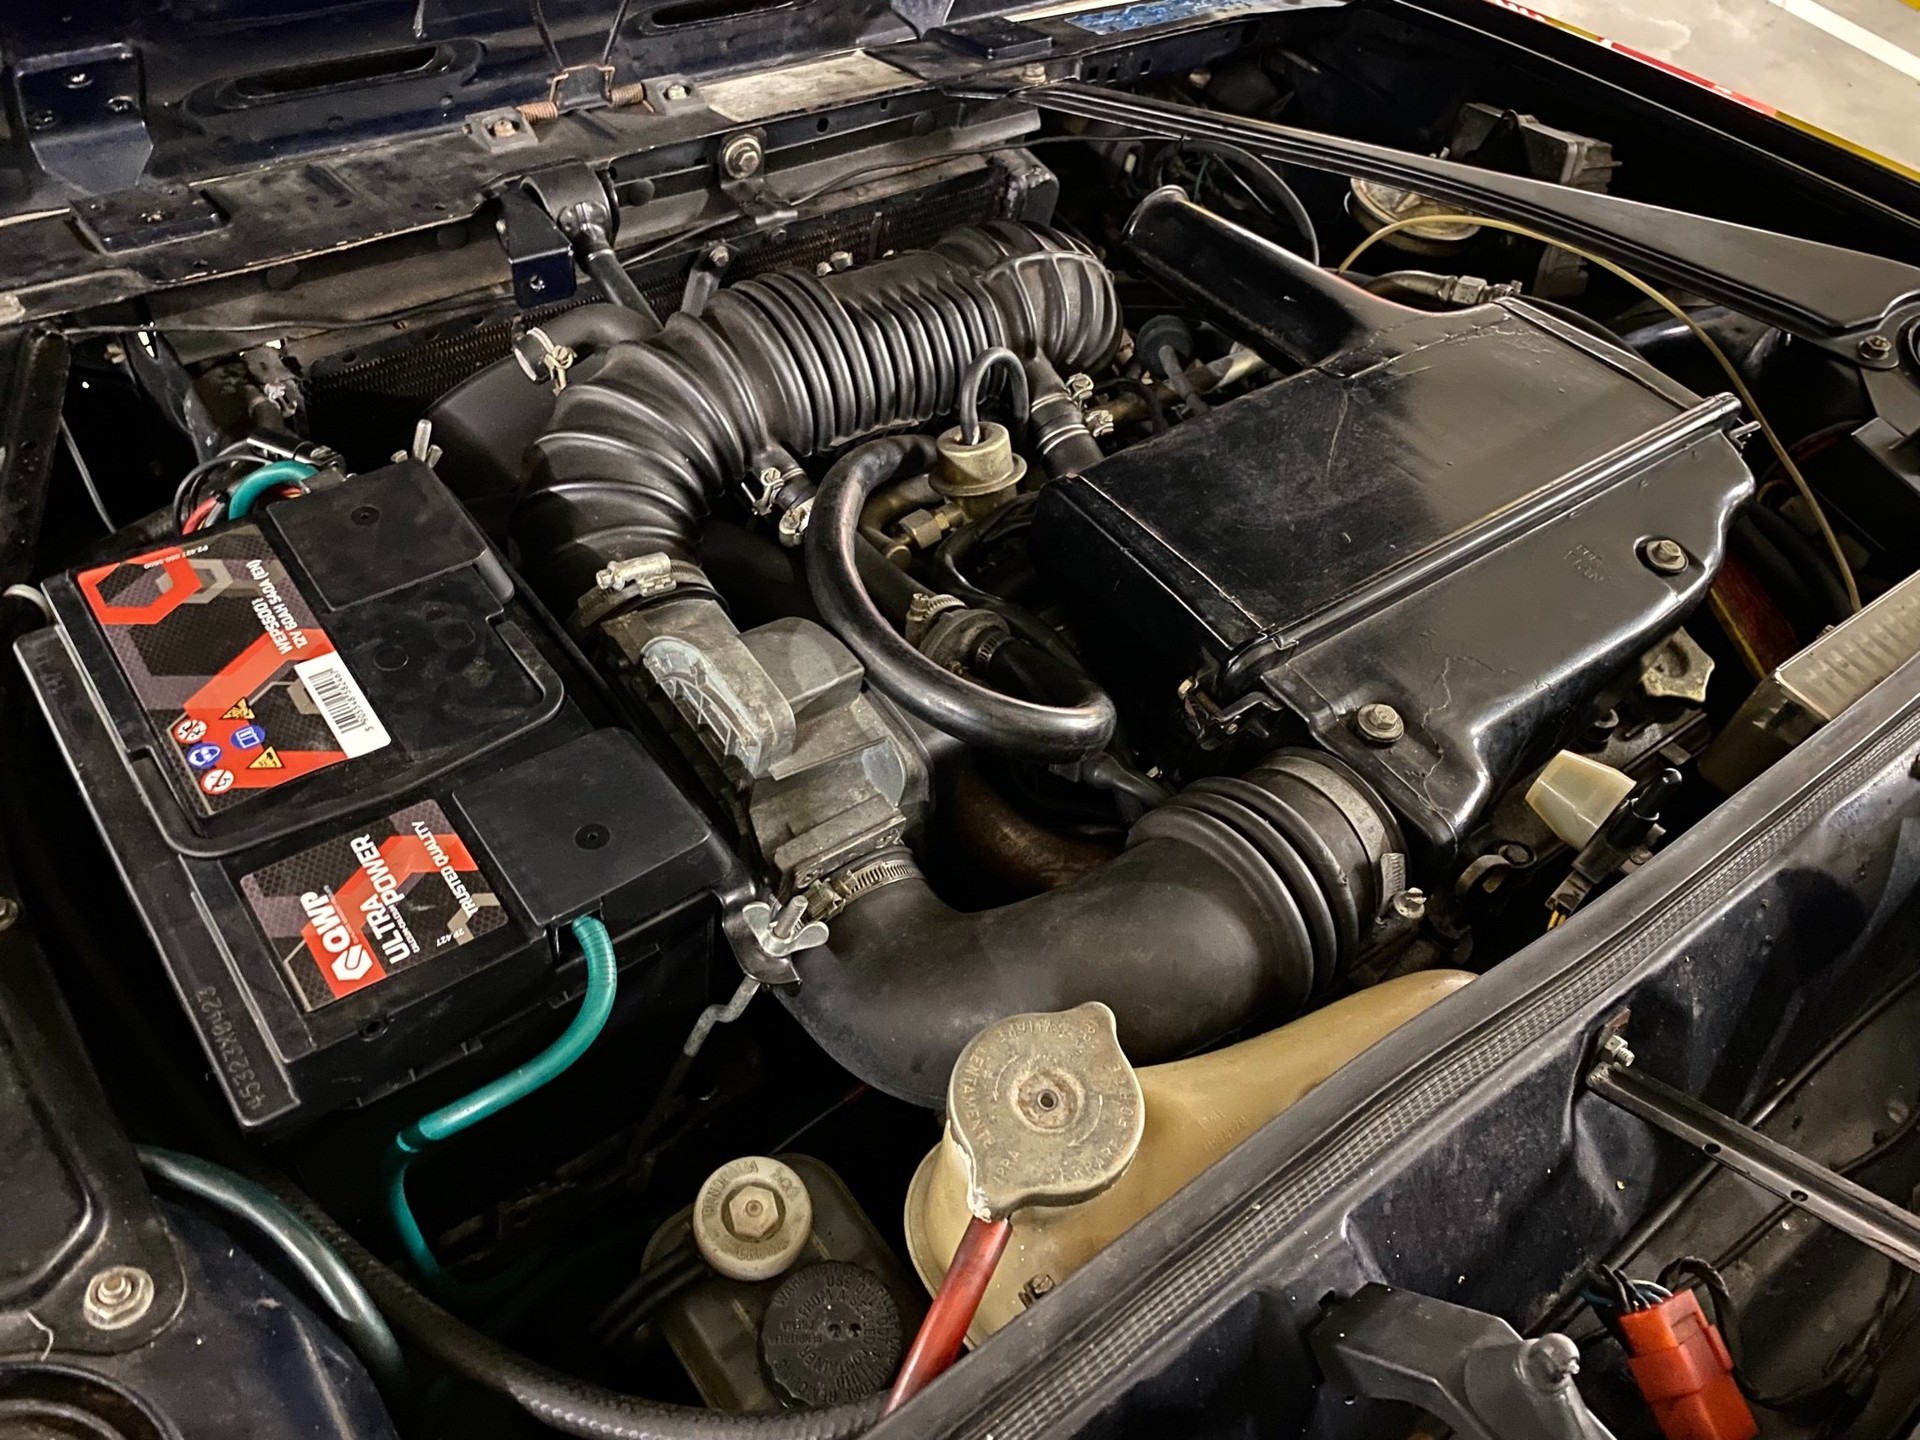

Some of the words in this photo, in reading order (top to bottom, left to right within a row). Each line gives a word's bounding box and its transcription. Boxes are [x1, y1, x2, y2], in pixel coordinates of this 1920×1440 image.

[246, 560, 269, 580] (EN)
[259, 578, 282, 605] 540A
[273, 603, 297, 631] 60AH
[289, 632, 307, 648] 12V
[412, 822, 449, 866] QUALITY
[351, 835, 404, 909] POWER
[440, 864, 479, 918] TRUSTED
[300, 892, 344, 952] QWP
[360, 895, 410, 964] ULTRA
[961, 1045, 993, 1147] LENTAMENTE
[826, 1274, 851, 1289] USE
[797, 1288, 832, 1317] FROM
[797, 1345, 870, 1375] CONTAINER
